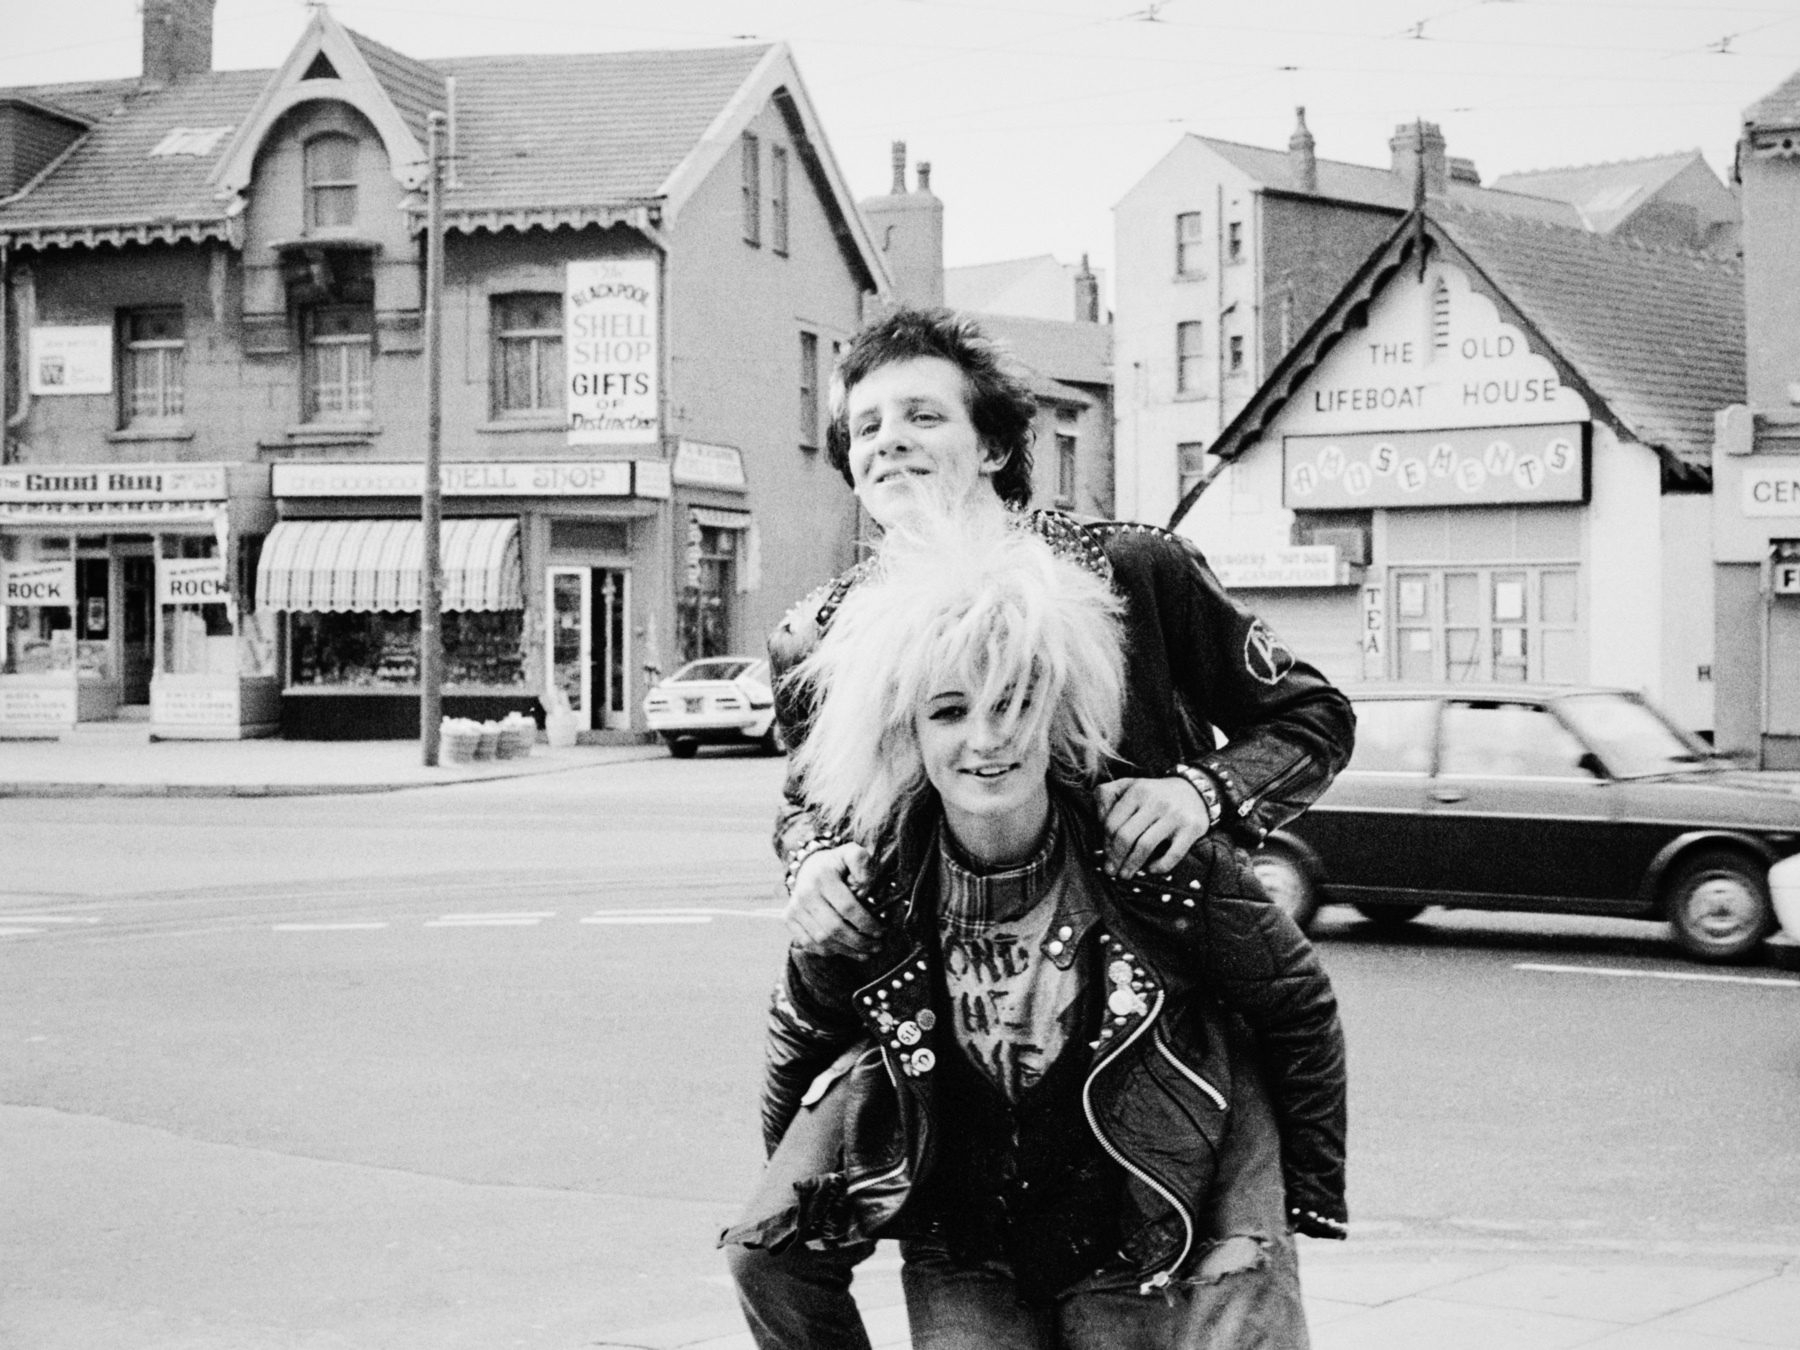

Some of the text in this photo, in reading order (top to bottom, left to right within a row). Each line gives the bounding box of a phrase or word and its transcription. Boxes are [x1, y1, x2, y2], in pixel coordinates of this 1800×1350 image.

[573, 314, 652, 338] SHELL
[573, 341, 652, 364] SHOP
[1369, 335, 1515, 365] THE OLD
[572, 372, 649, 397] GIFTS
[1314, 378, 1559, 413] LIFEBOAT HOUSE
[596, 399, 623, 410] OF
[440, 466, 517, 490] HELL
[1293, 442, 1569, 491] AMUSEMENTS
[25, 474, 98, 491] Good
[108, 474, 162, 492] Buy
[7, 582, 61, 599] ROCK
[1366, 588, 1381, 654] TEA
